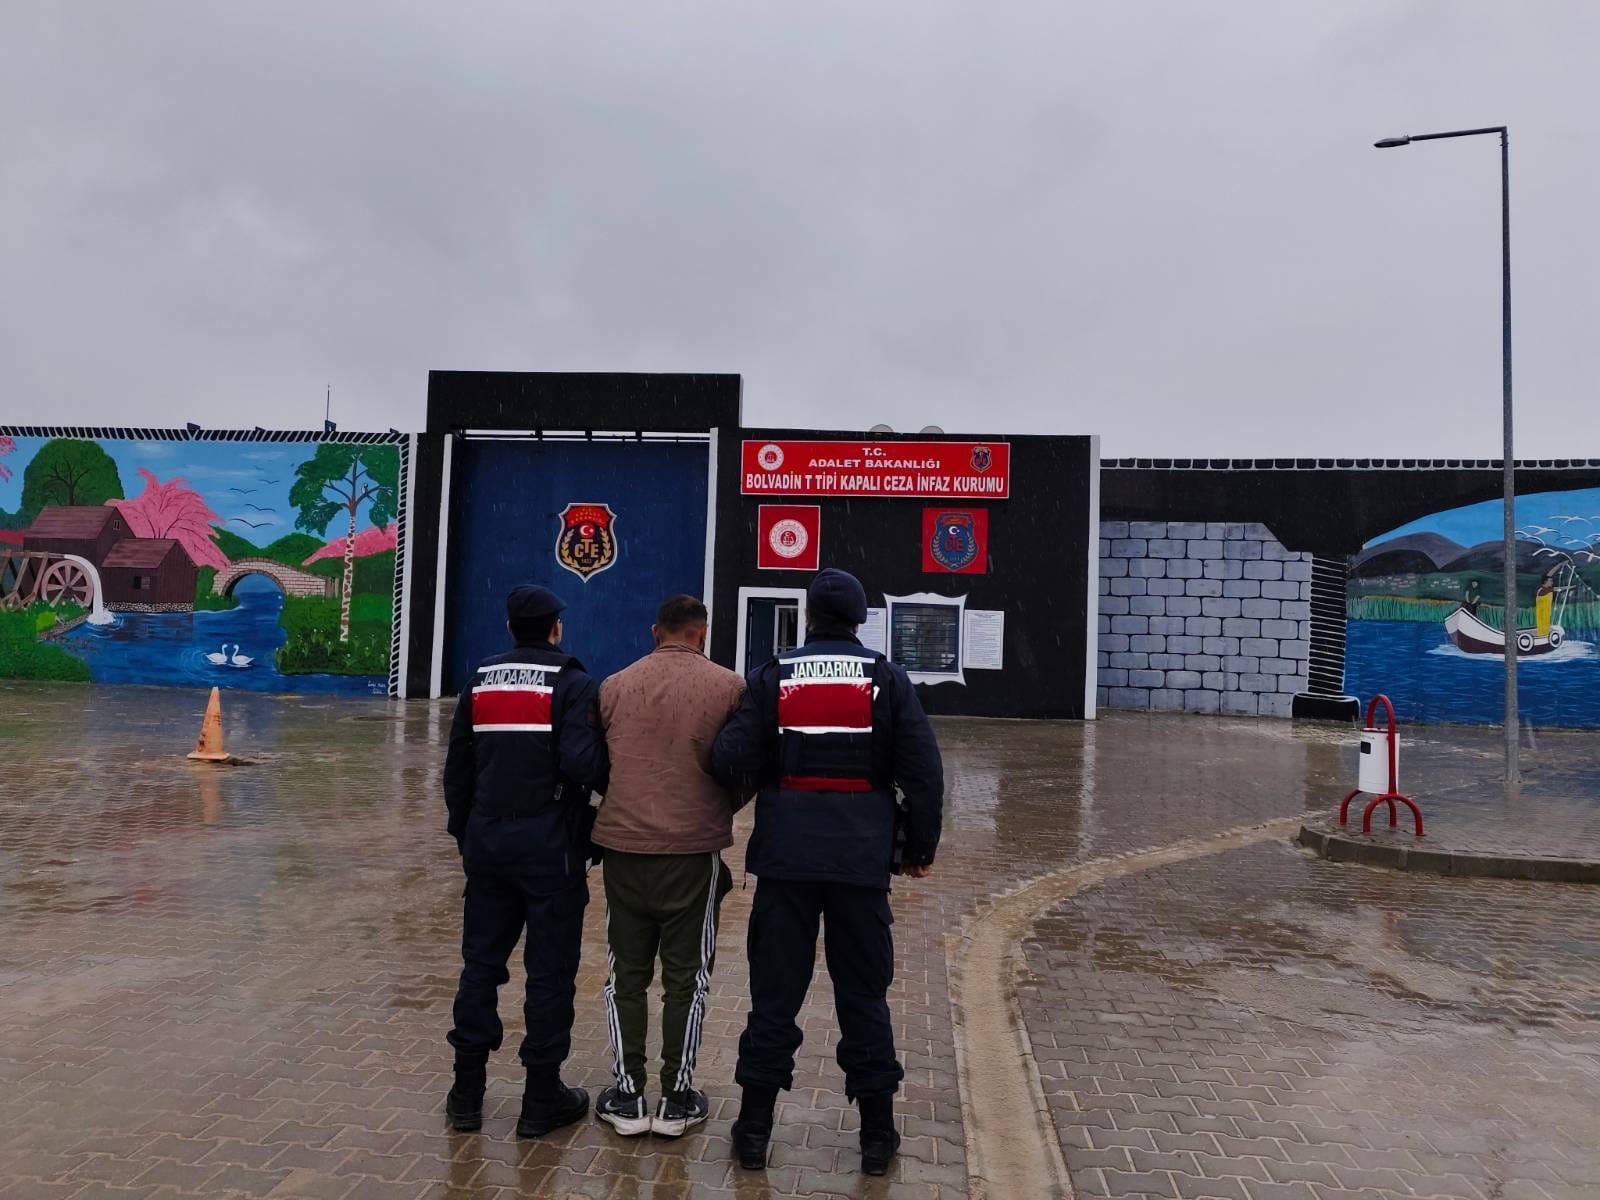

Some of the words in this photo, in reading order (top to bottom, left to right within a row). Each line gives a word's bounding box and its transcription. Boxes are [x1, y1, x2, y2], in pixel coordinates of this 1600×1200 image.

[862, 447, 887, 457] T.C.
[808, 459, 861, 468] ADALET
[865, 459, 941, 469] BAKANLIĞI
[746, 471, 801, 489] BOLVADİN
[805, 475, 812, 489] T
[815, 472, 837, 490] TİPİ
[840, 475, 881, 491] KAPALI
[883, 475, 914, 491] CEZA
[917, 473, 951, 492] İNFAZ
[953, 476, 1004, 492] KURUMU
[480, 669, 546, 686] JANDARMA
[789, 661, 865, 679] JANDARMA
